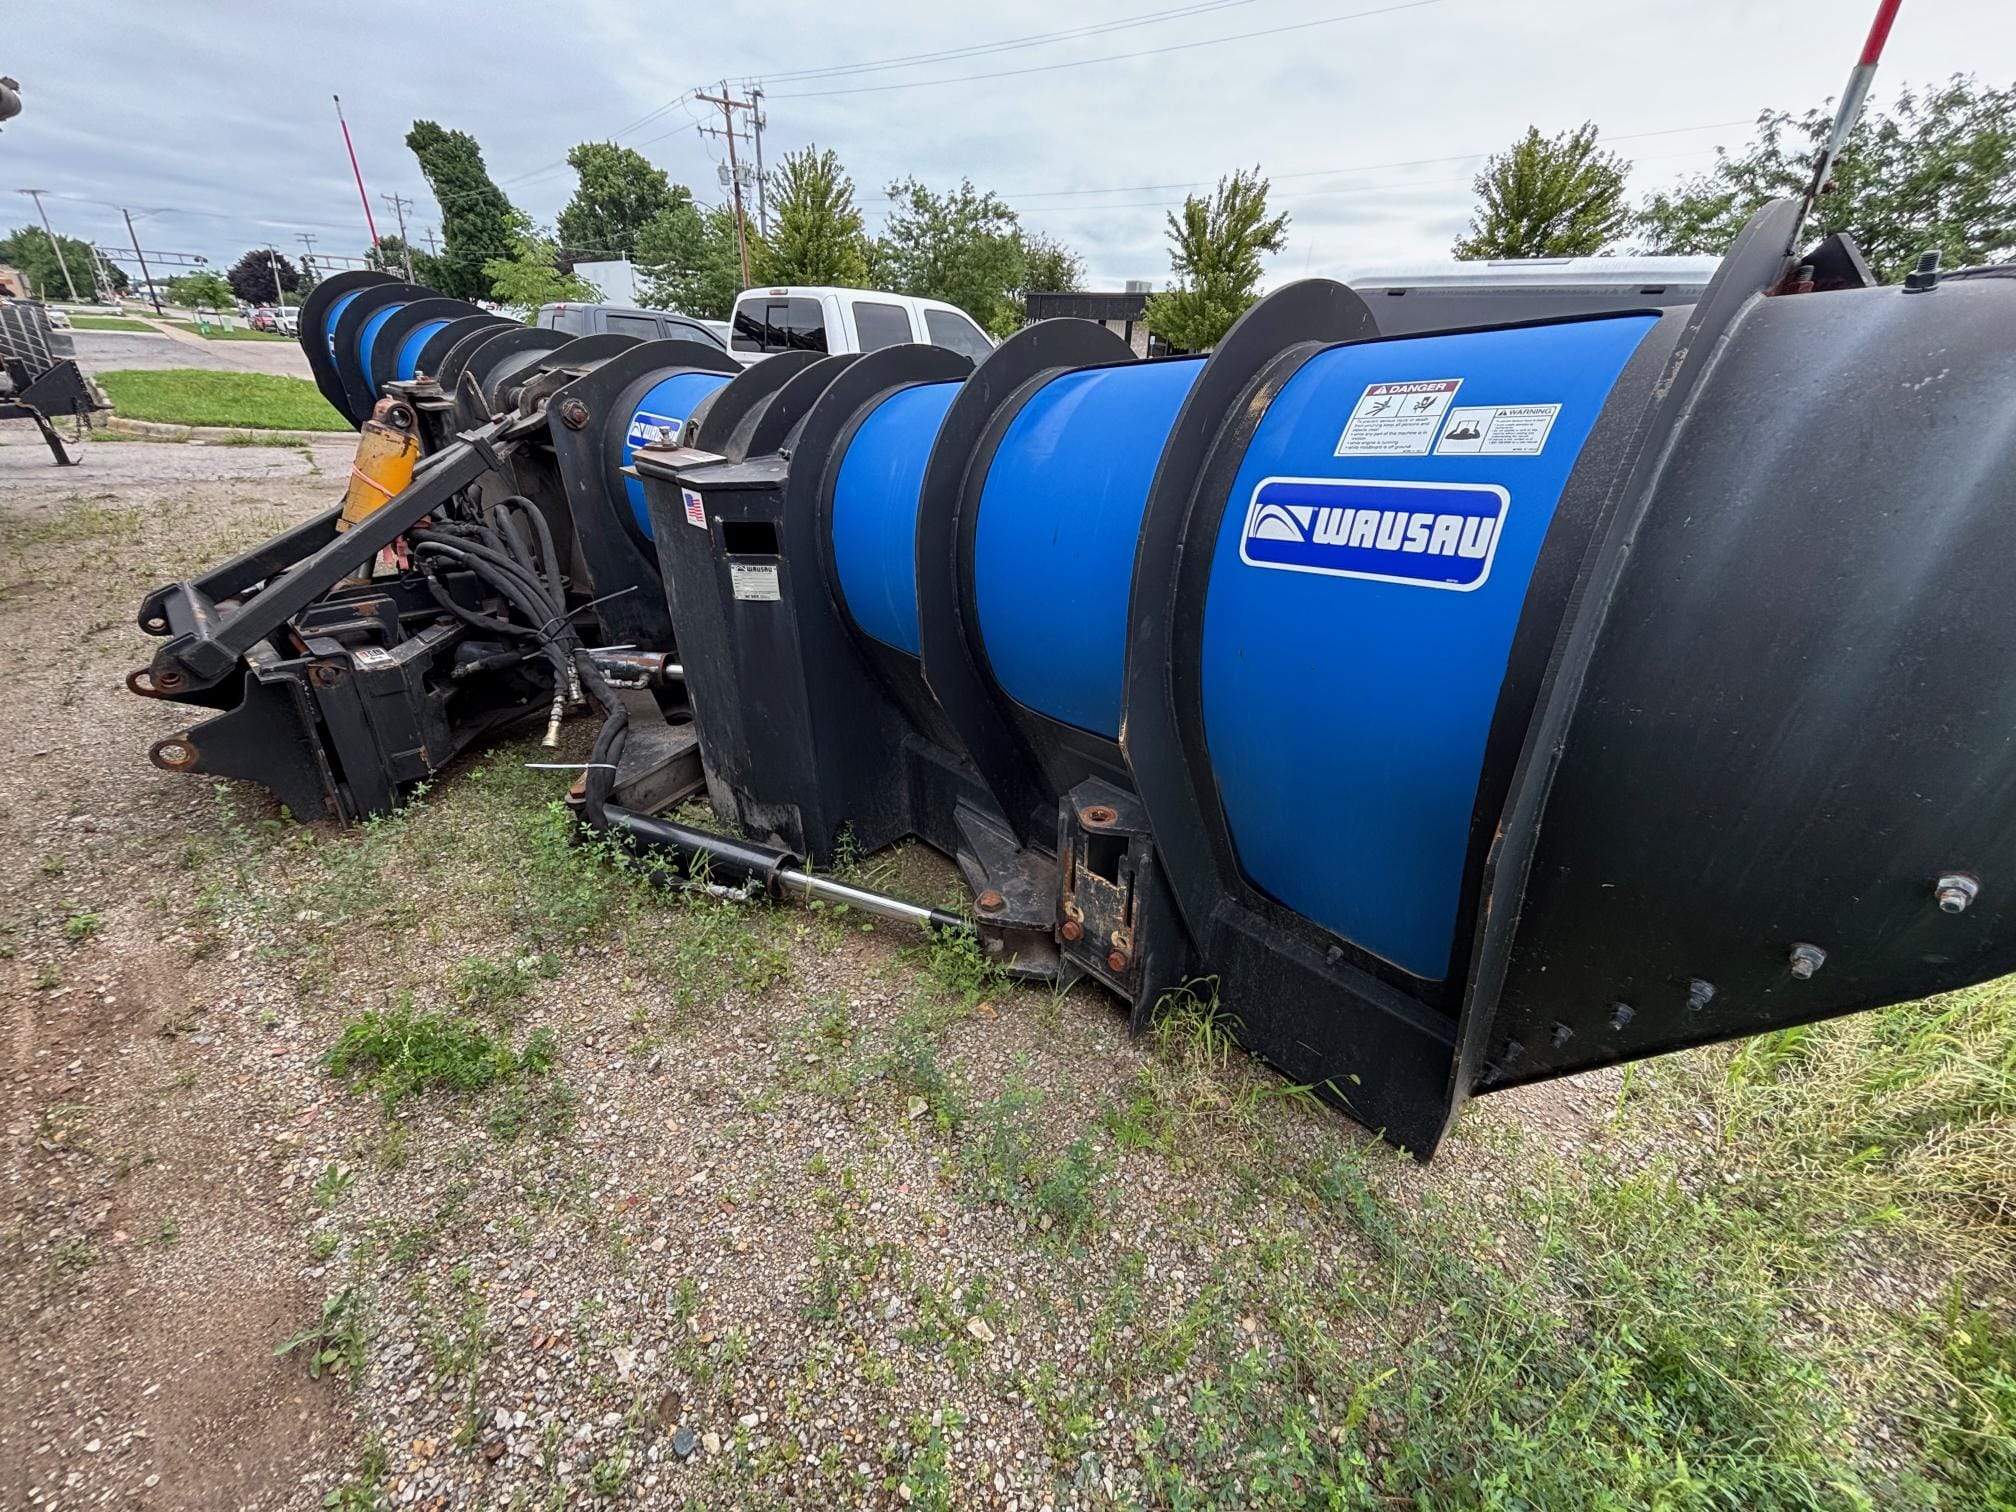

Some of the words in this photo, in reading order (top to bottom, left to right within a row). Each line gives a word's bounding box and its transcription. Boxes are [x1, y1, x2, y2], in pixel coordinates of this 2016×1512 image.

[1389, 383, 1447, 394] DANGER
[1509, 408, 1553, 416] WARNING
[643, 424, 679, 443] WAUU
[1313, 507, 1497, 560] WAUSAU
